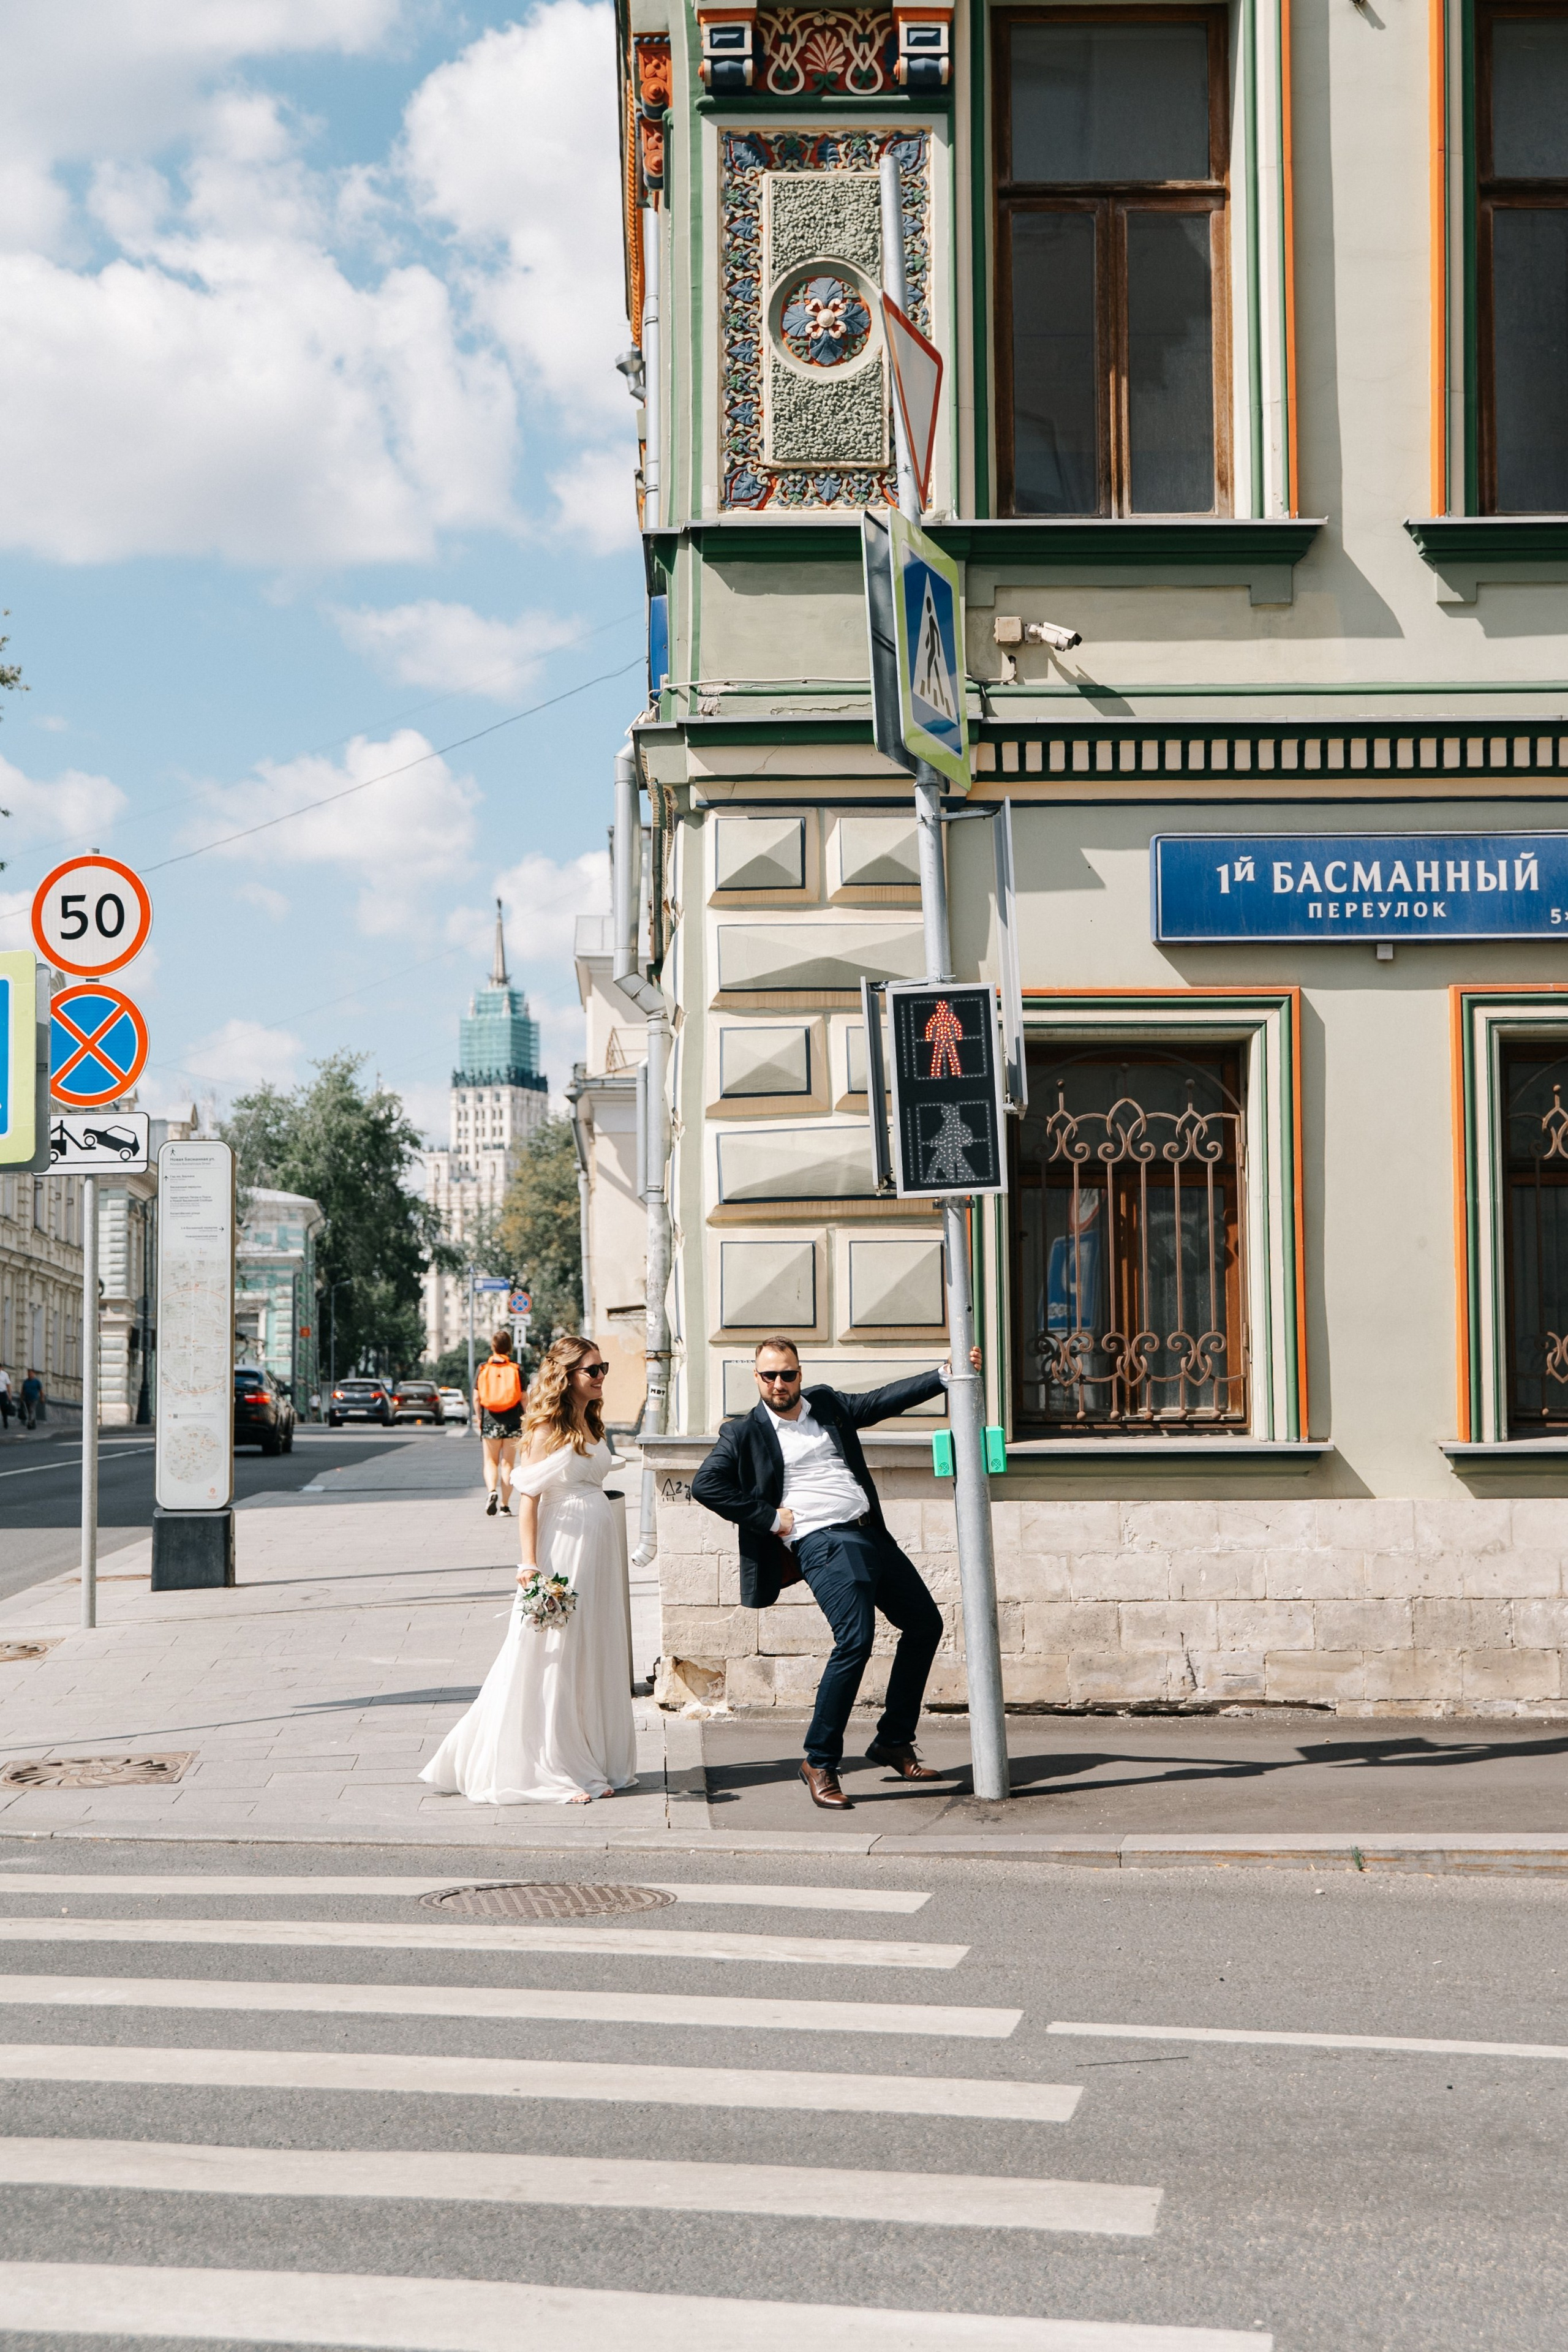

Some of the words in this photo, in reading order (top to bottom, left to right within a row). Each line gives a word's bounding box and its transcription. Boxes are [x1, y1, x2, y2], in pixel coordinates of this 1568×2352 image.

[1273, 852, 1539, 894] БАСМАННЫЙ
[60, 893, 125, 940] 50
[1308, 902, 1447, 918] ПЕРЕУЛОК
